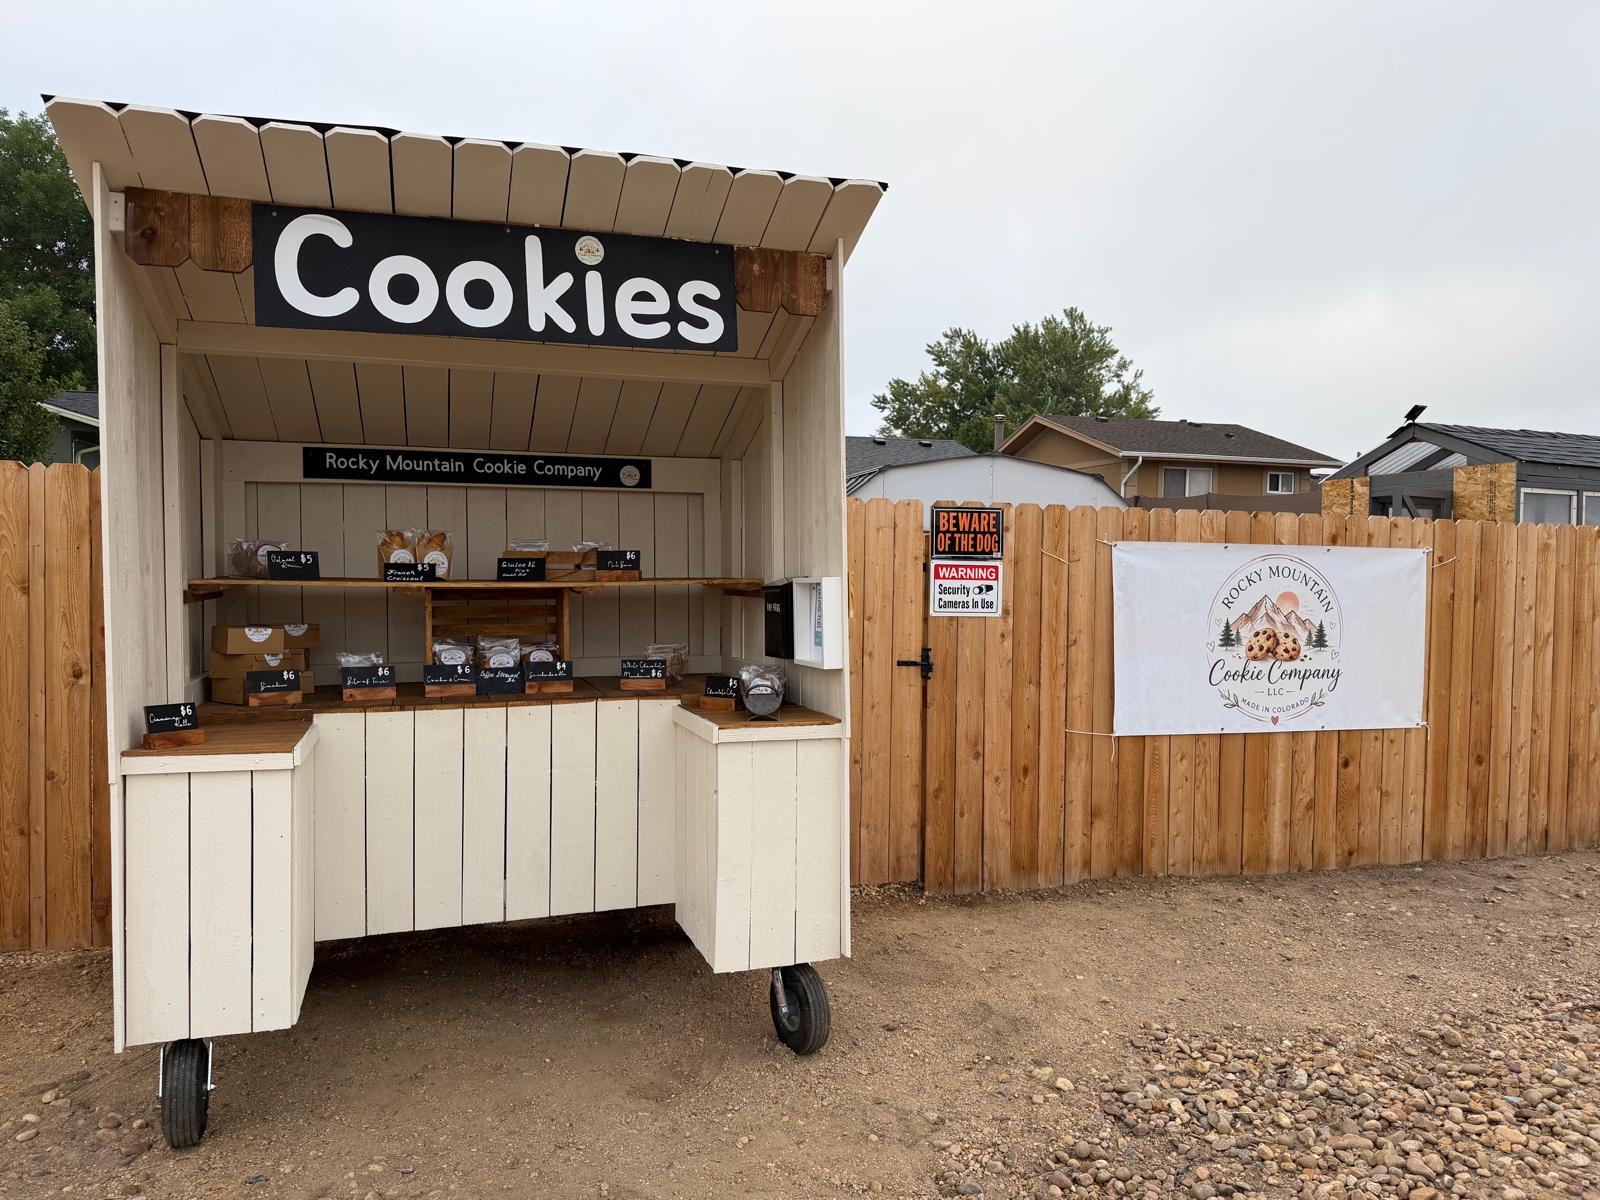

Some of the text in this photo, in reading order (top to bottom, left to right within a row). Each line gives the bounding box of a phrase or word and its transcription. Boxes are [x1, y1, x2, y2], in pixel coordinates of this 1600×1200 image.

[274, 213, 725, 344] Cookies
[325, 453, 380, 474] Rocky
[386, 454, 465, 473] Mountain
[473, 458, 527, 475] Cookie
[534, 460, 603, 482] Company
[939, 512, 997, 532] BEWARE
[937, 533, 999, 553] OF THE DOG
[300, 553, 313, 564] $5
[626, 550, 636, 560] $6
[417, 563, 430, 571] $5
[938, 567, 996, 579] WARNING
[938, 583, 970, 597] Security
[1221, 565, 1334, 613] ROCKY MOUNTAIN
[938, 597, 994, 609] Cameras In Use
[377, 667, 390, 676] $6
[556, 661, 567, 671] $4
[283, 670, 295, 680] $6
[651, 668, 662, 678] $6
[1208, 658, 1343, 692] Cookie Company
[729, 678, 738, 689] $5
[1267, 687, 1284, 696] LLC
[1241, 697, 1260, 711] MADE
[1272, 696, 1309, 713] COLORADO
[180, 705, 192, 717] $6
